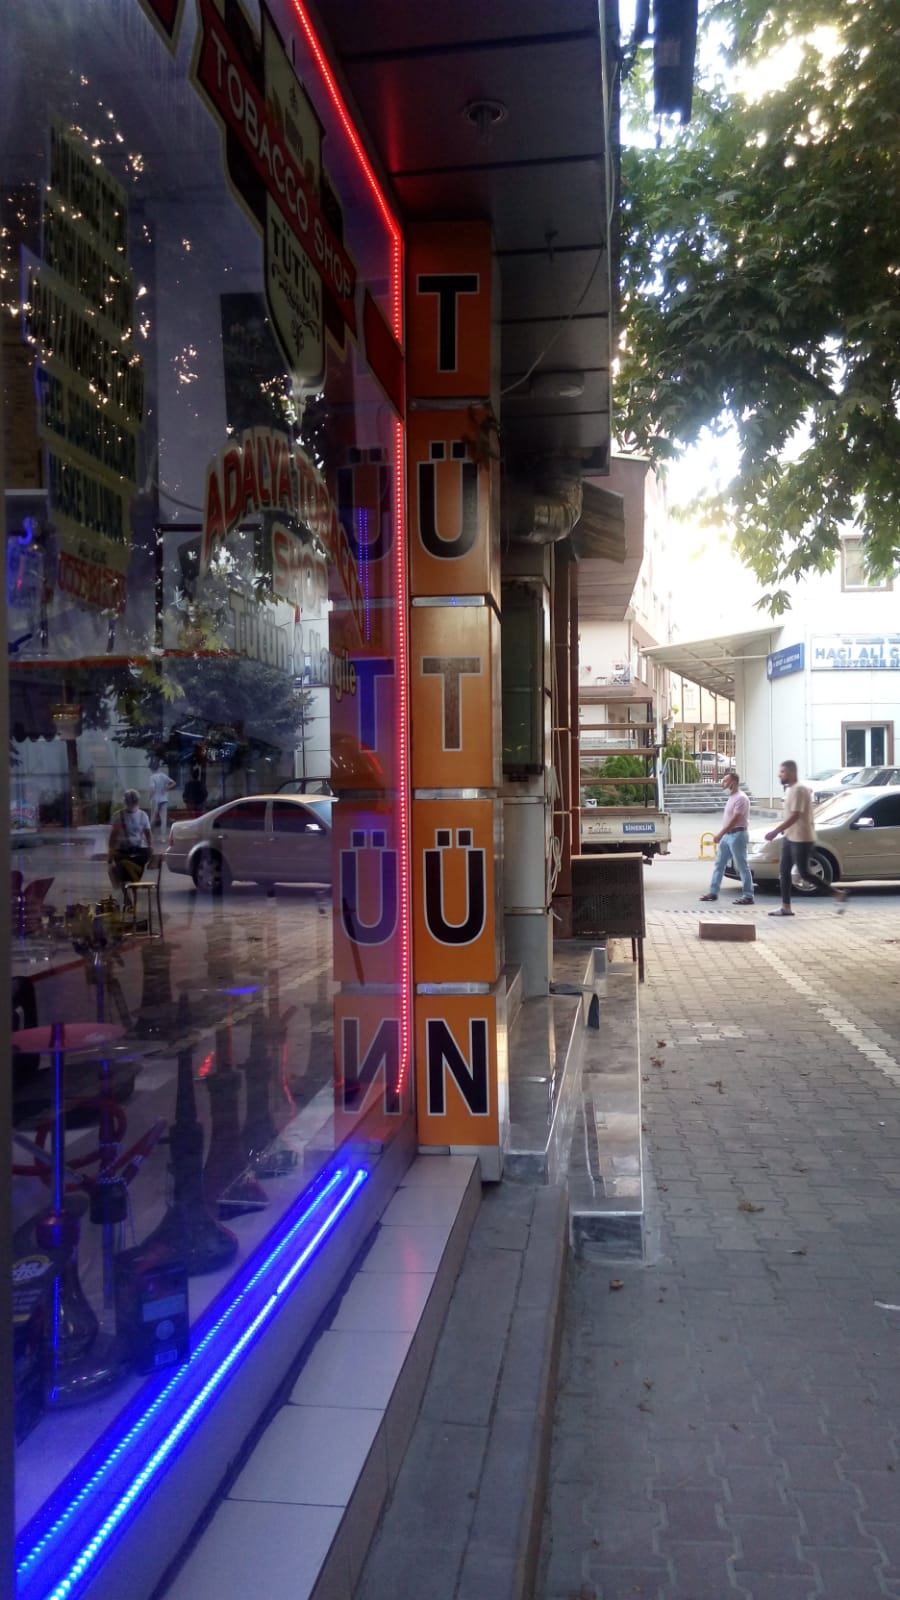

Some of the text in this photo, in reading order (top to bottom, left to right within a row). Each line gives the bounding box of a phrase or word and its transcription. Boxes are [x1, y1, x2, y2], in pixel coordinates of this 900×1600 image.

[210, 29, 310, 234] TOBACCO
[313, 223, 352, 302] SHOP
[270, 215, 321, 320] TÜTÜN
[201, 430, 294, 565] ADALYA
[273, 528, 328, 612] SHOP
[293, 622, 304, 677] &
[308, 628, 357, 702] Nargile
[416, 272, 490, 1118] TÜTÜN
[858, 644, 884, 659] ALİ
[625, 823, 655, 832] SİNEKLİK
